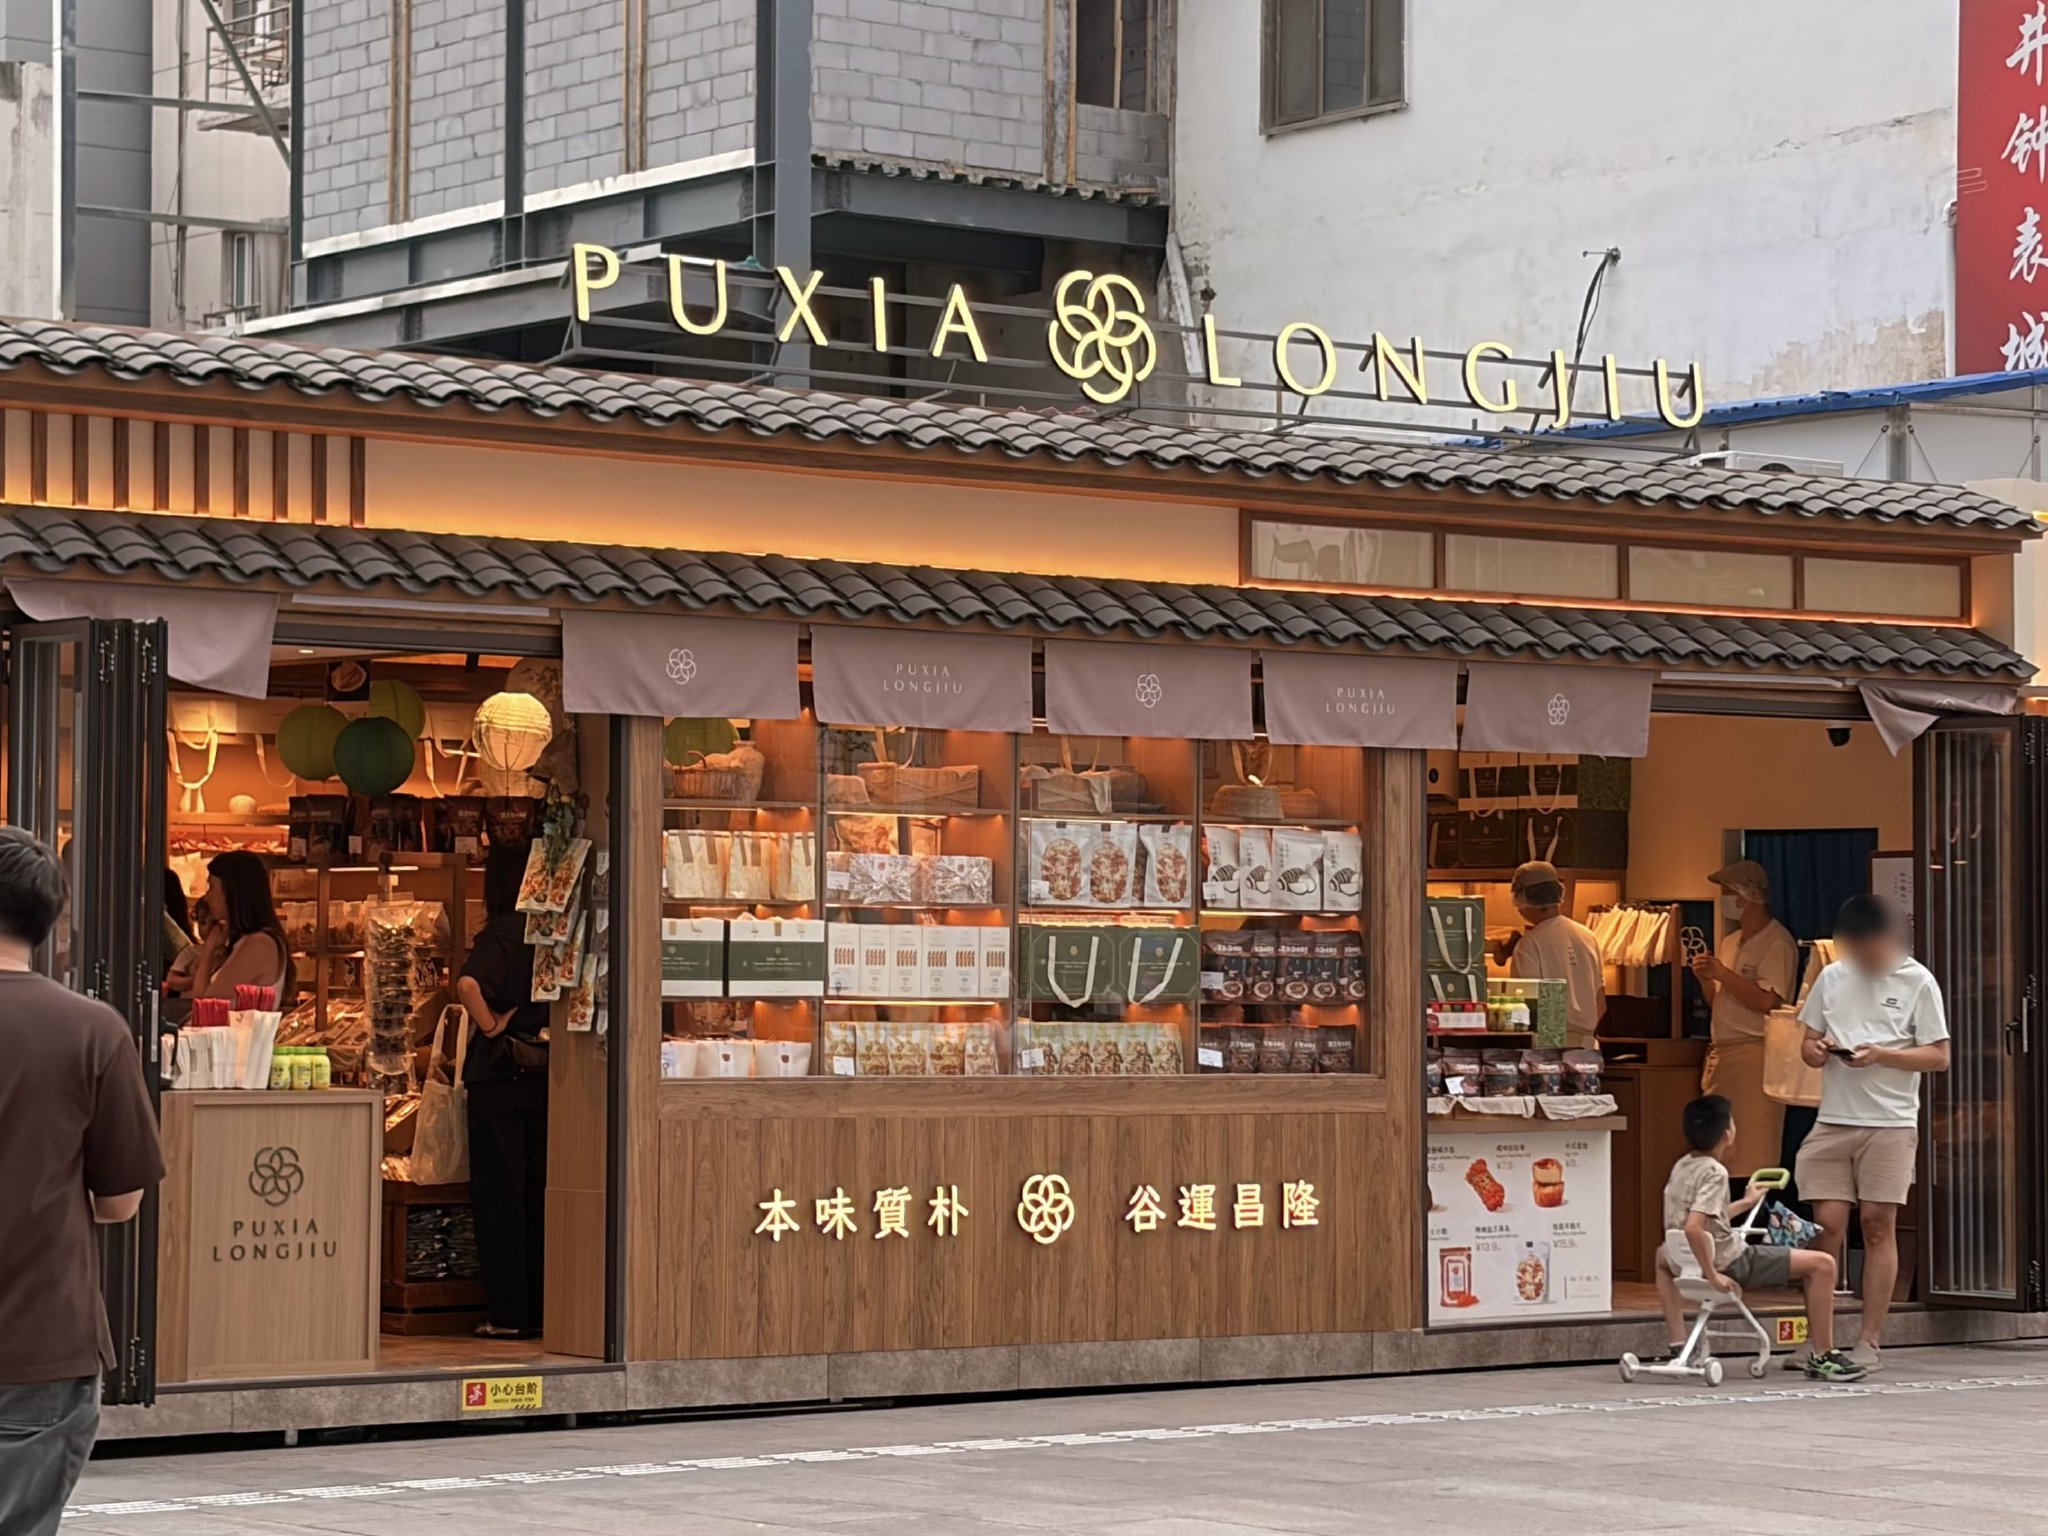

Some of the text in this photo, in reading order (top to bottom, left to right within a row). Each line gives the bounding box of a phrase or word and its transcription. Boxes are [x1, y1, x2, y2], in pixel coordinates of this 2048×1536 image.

[571, 242, 1705, 429] PUXIA LONGJIU
[895, 662, 951, 678] PUXIA
[882, 678, 964, 695] LONGJIU
[1336, 686, 1386, 700] PUXIA
[1325, 701, 1396, 716] LONGJIU
[754, 1180, 1321, 1242] 本味質朴 谷運昌隆
[232, 1218, 319, 1238] PUXIA
[212, 1240, 337, 1263] LONGJIU
[490, 1381, 538, 1397] 小心台阶
